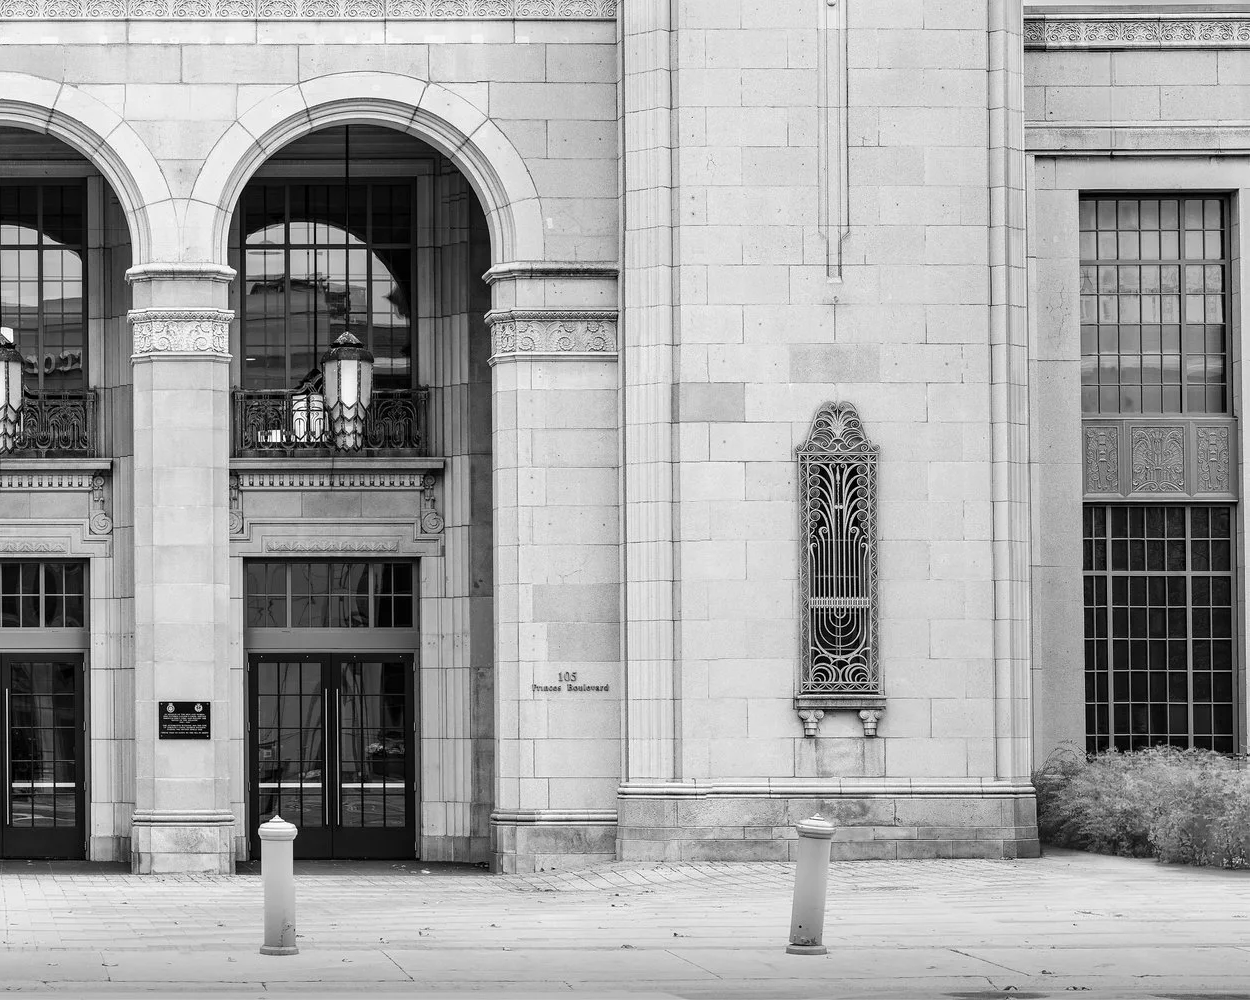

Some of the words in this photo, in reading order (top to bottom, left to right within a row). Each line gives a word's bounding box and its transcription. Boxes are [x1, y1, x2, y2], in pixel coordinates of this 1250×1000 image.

[557, 671, 578, 682] 105
[531, 683, 562, 692] Princes
[566, 683, 610, 692] Boulevard
